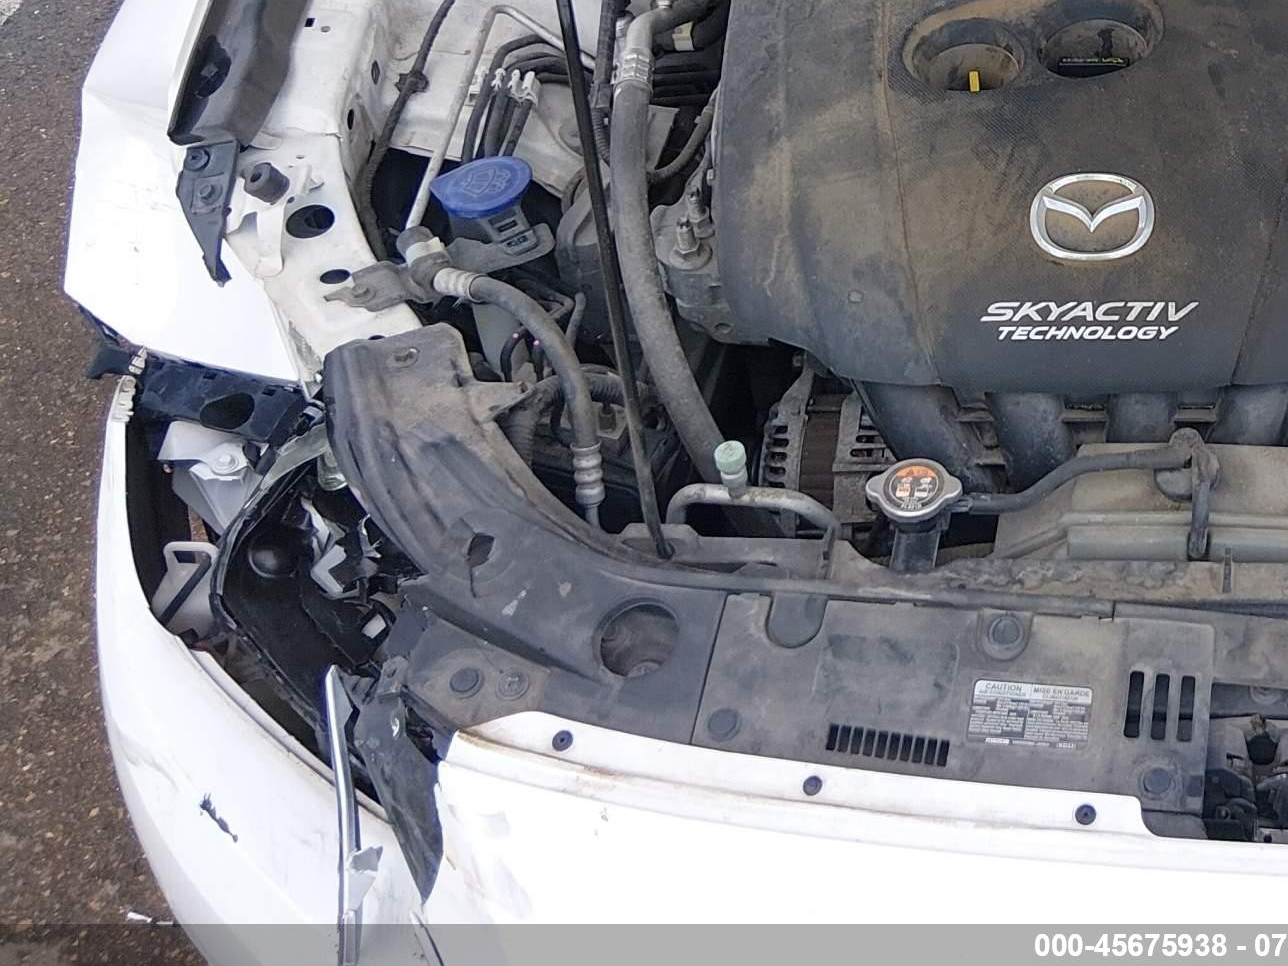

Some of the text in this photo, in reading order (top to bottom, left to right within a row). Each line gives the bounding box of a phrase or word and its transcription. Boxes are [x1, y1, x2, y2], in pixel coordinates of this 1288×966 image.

[980, 300, 1200, 322] SKYACTIV
[997, 325, 1180, 341] TECHNOLOGY
[985, 682, 1023, 692] CAUTION
